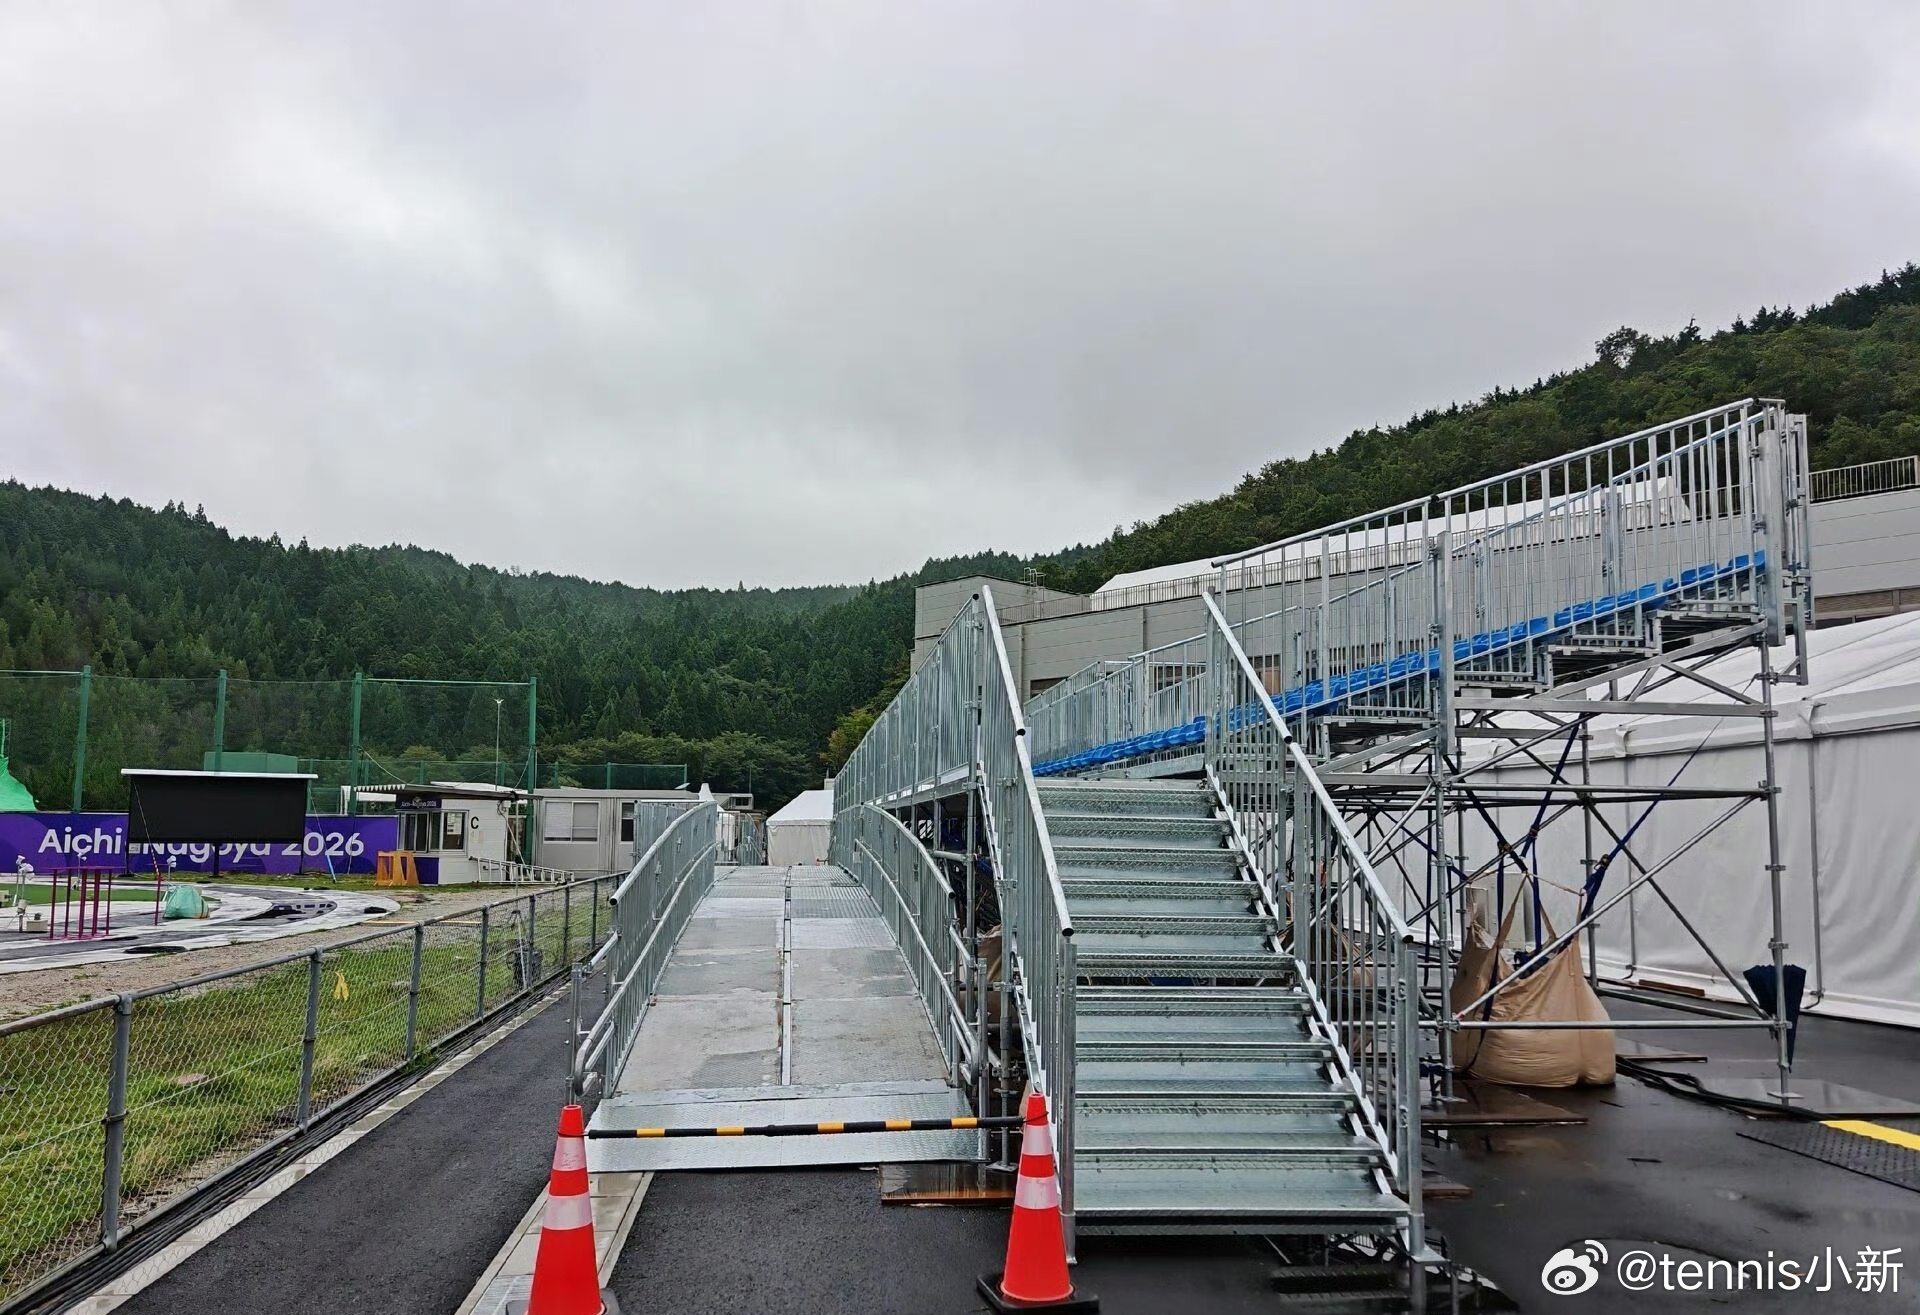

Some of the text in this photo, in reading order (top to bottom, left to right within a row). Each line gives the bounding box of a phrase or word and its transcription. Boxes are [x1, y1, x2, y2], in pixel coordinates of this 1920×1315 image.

[470, 816, 479, 829] C
[38, 826, 364, 863] Aichiagya 2026
